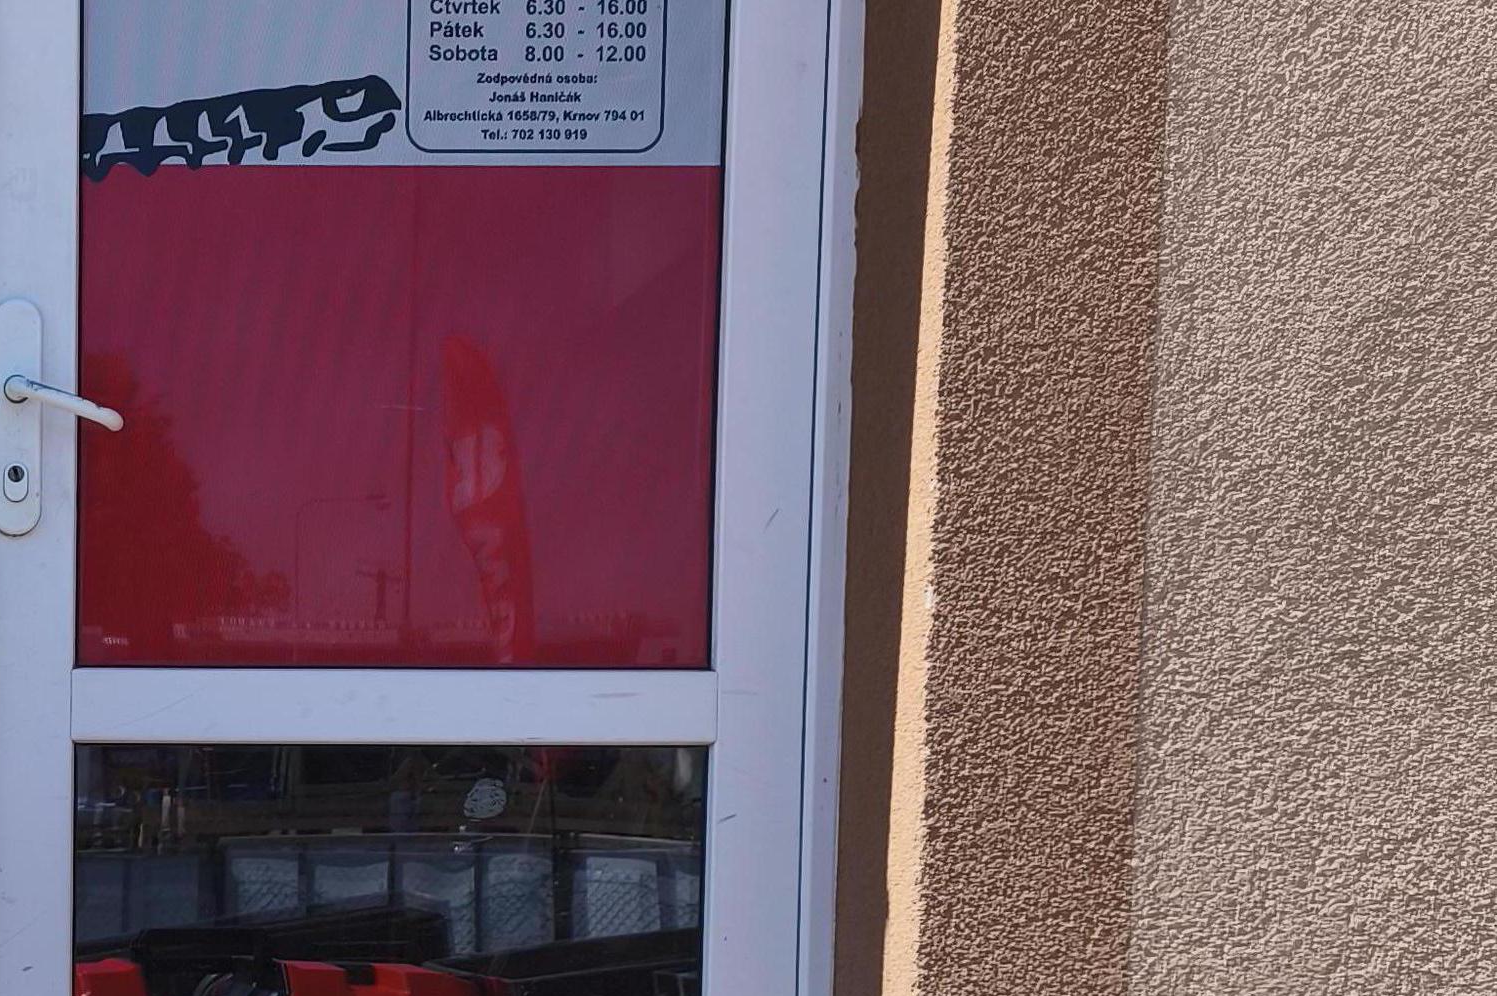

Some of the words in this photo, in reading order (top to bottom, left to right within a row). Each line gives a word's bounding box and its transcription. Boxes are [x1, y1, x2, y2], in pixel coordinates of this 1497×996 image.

[525, 0, 566, 16] 6.30
[596, 0, 648, 16] 16.00
[430, 21, 485, 39] Pátek
[525, 21, 565, 39] 6.30
[596, 21, 647, 39] 16.00
[428, 44, 498, 62] Sobota
[524, 45, 565, 63] 8.00
[596, 44, 647, 63] 12.00
[555, 72, 598, 85] osoba:
[488, 91, 526, 103] Jonáš
[506, 109, 560, 124] 1658/79,
[562, 109, 601, 122] Krnov
[603, 109, 627, 122] 794
[629, 109, 645, 122] 01
[511, 128, 534, 141] 702
[538, 128, 562, 141] 130
[564, 128, 588, 141] 919
